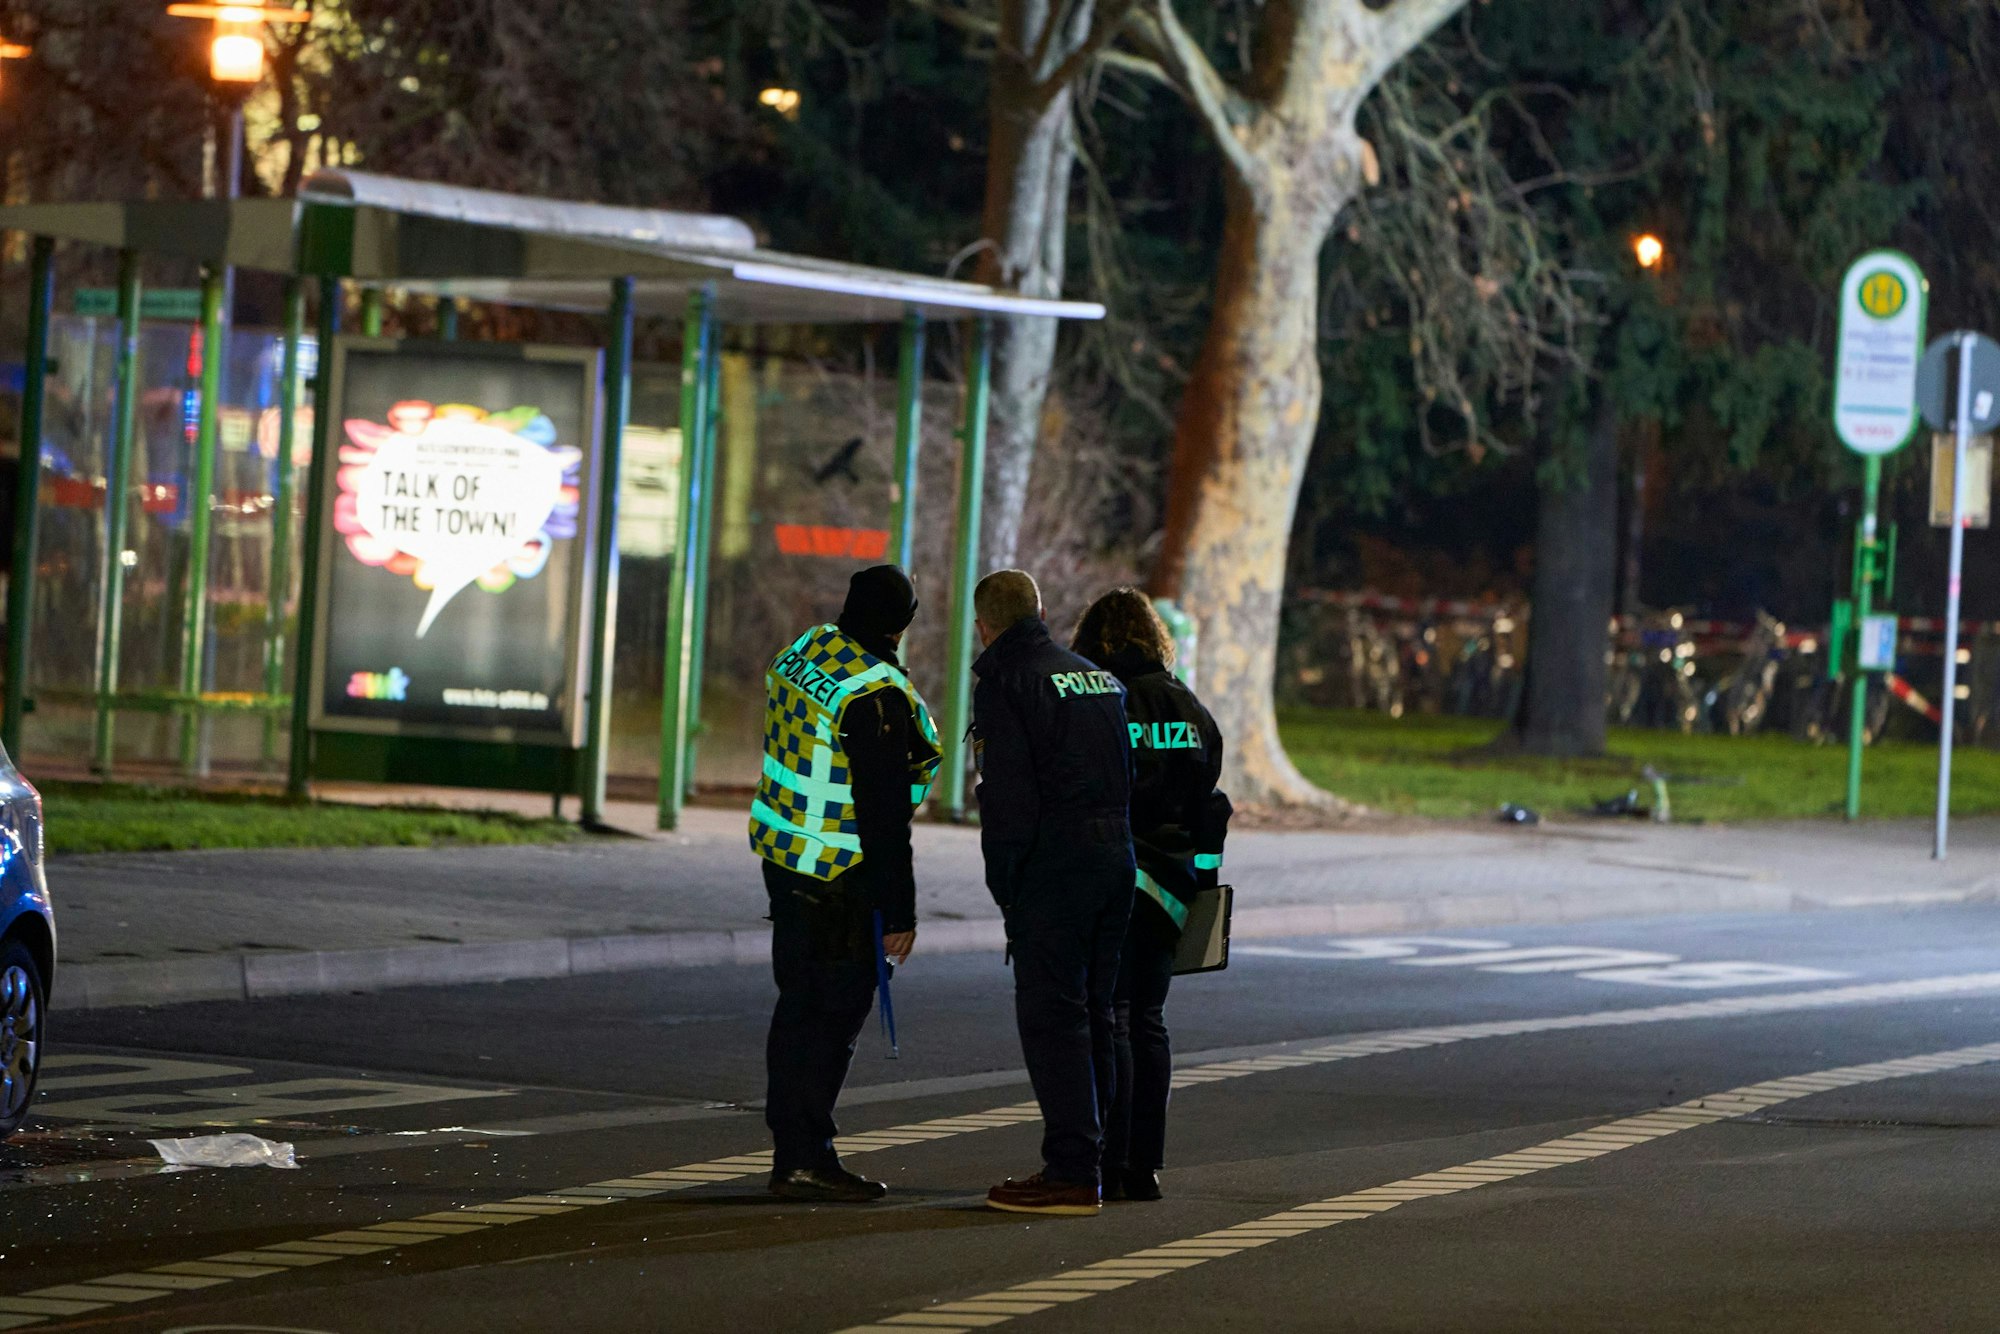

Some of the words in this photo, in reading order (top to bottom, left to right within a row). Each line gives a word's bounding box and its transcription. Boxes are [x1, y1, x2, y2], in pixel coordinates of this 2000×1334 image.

[383, 471, 439, 499] TALK
[453, 475, 482, 501] OF
[382, 504, 422, 532] THE
[436, 508, 516, 537] TOWN!
[775, 651, 841, 707] POLIZEI
